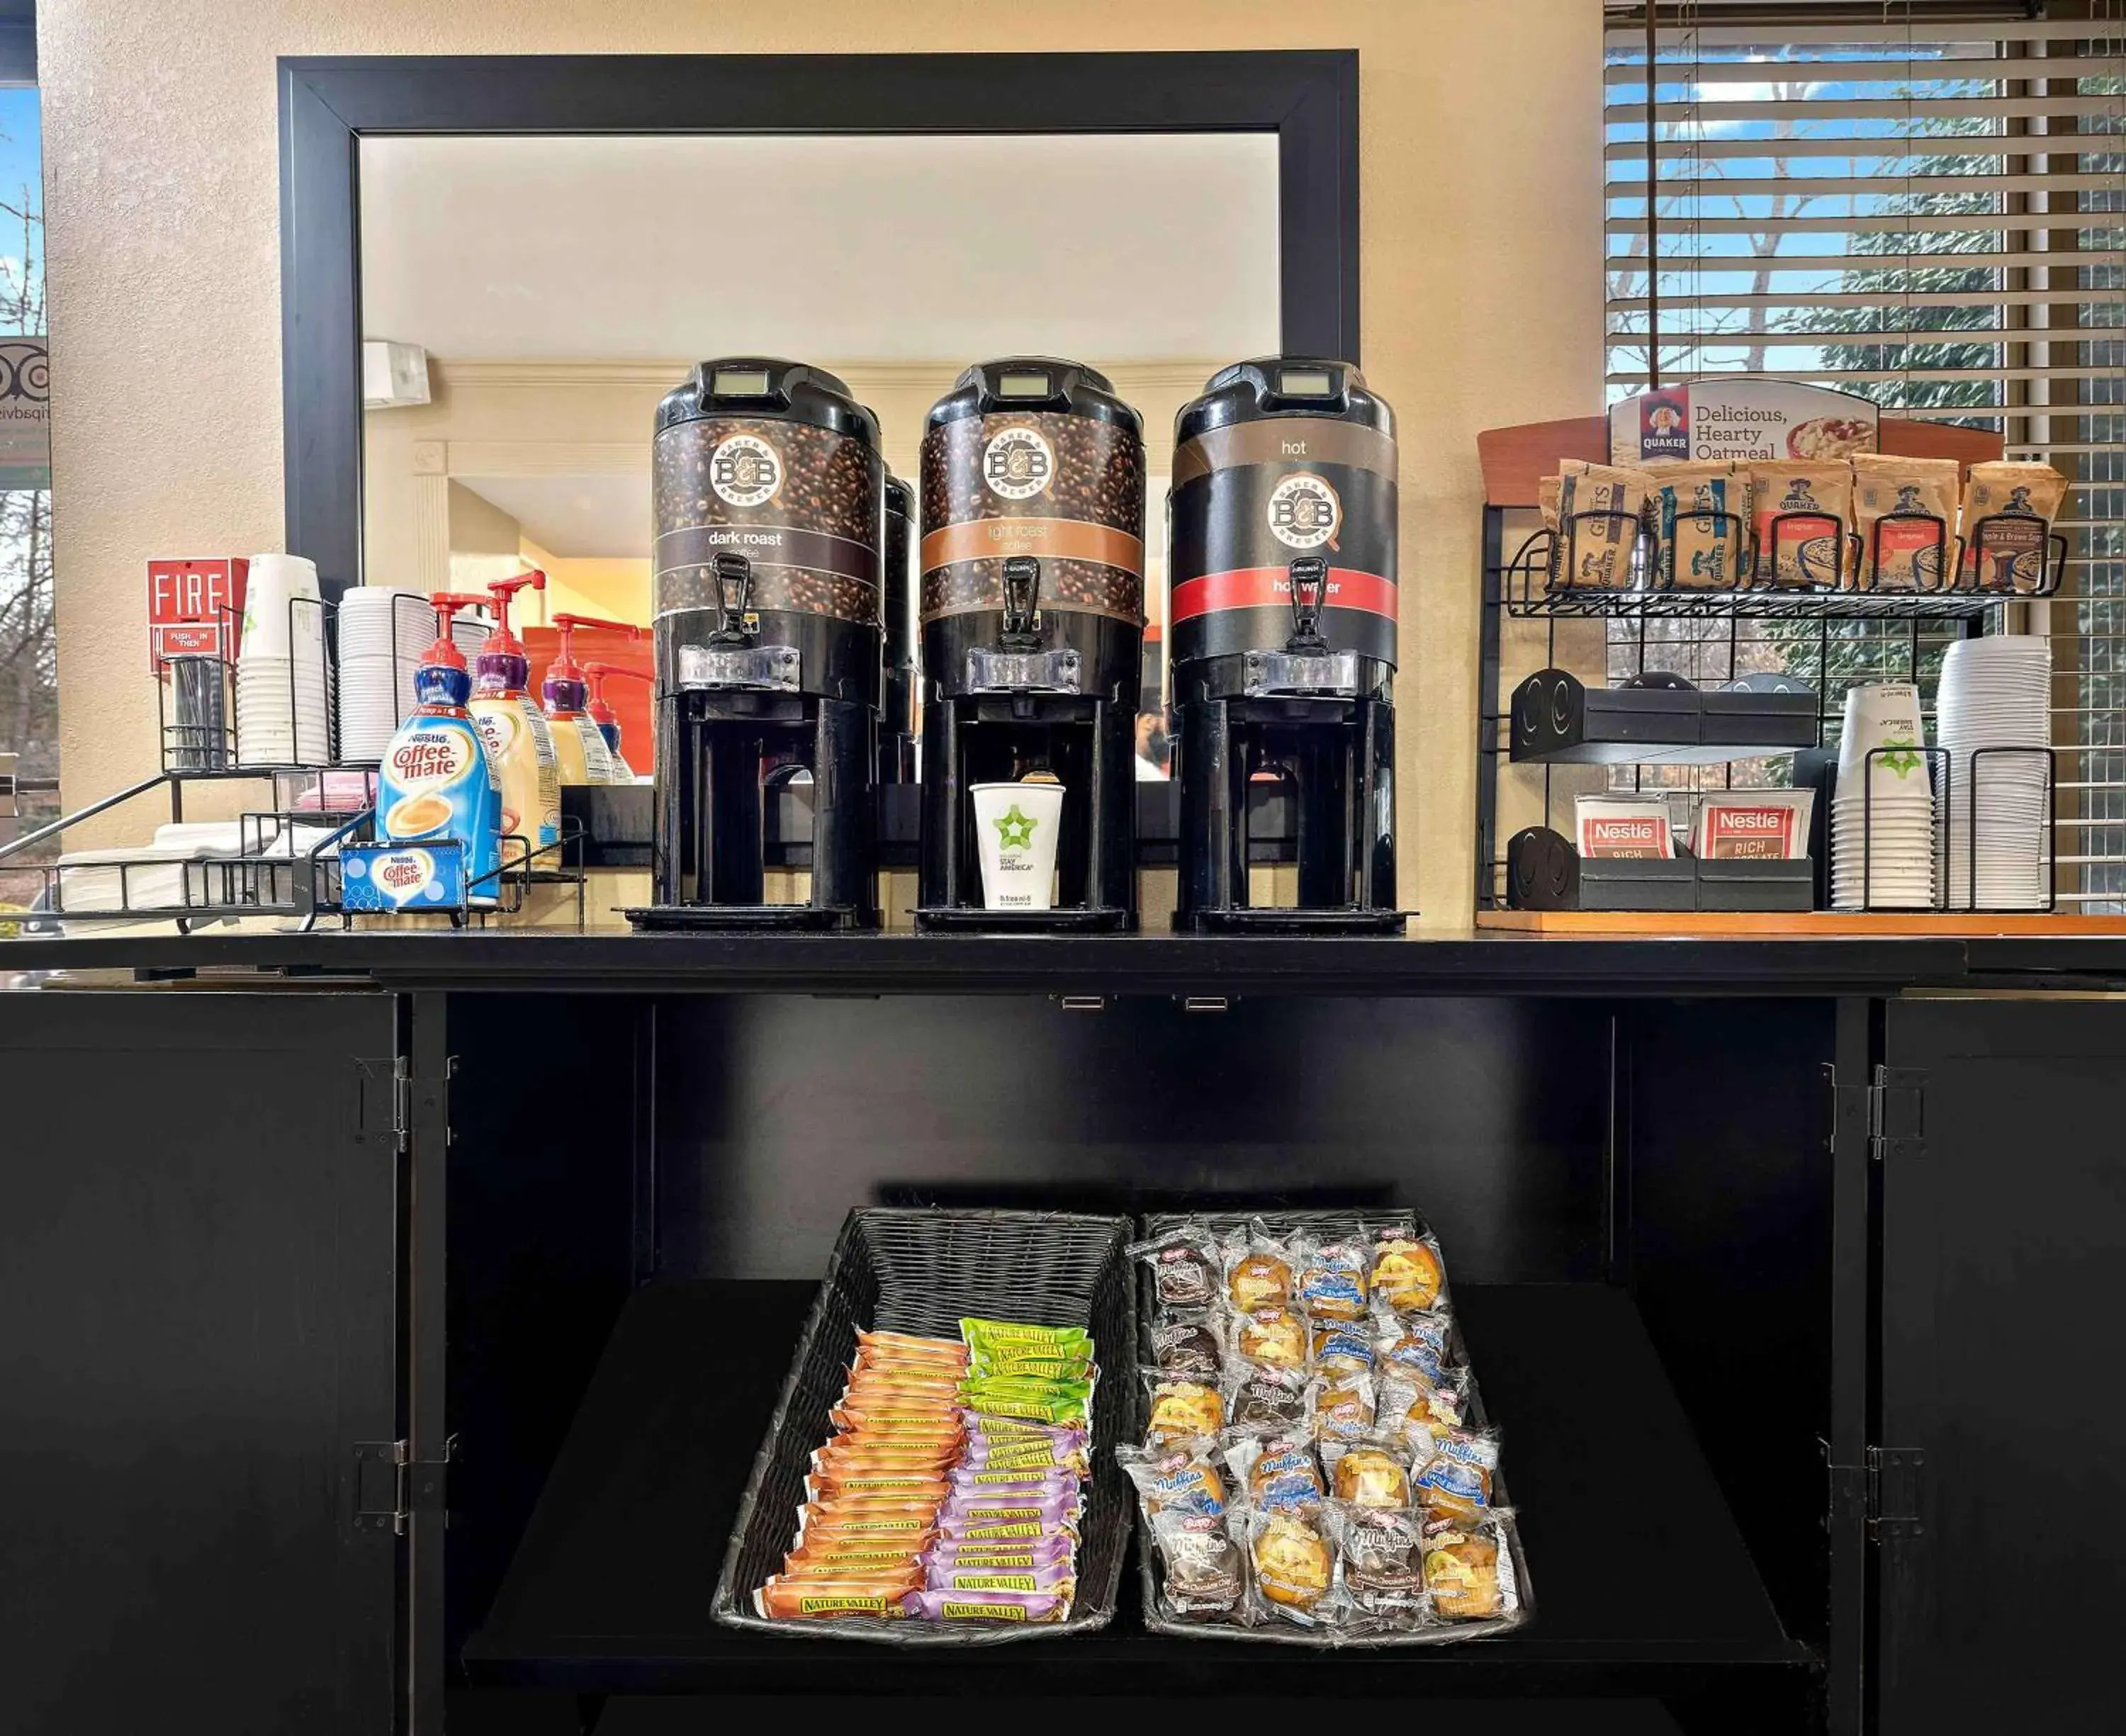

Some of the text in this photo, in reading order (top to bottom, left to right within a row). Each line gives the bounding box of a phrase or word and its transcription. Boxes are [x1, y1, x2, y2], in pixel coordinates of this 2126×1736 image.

[1696, 405, 1787, 424] Delicious,
[1643, 438, 1687, 449] QUAKER
[1696, 426, 1762, 445] Hearty
[1282, 440, 1306, 454] hot
[1696, 443, 1775, 461] Oatmeal
[715, 456, 776, 487] B&B
[987, 449, 1048, 478] B&B
[1273, 497, 1333, 529] B&B
[1780, 502, 1820, 511] QUAKER
[709, 532, 782, 546] dark roast
[1714, 543, 1725, 581] QUAKER
[154, 574, 223, 616] FIRE
[408, 733, 448, 743] Nestlé
[403, 759, 457, 779] mate
[1735, 840, 1765, 855] RICH
[393, 873, 422, 889] mate
[1436, 1438, 1483, 1464] Muffins
[1262, 1454, 1310, 1472] Muffins
[1156, 1470, 1203, 1490] Muffins
[1429, 1472, 1482, 1497] Wild Blueberry
[1363, 1529, 1413, 1550] Muffins
[957, 1577, 1030, 1590] NATURE VALLEY
[804, 1599, 883, 1611] NATURE VALLEY
[946, 1603, 1023, 1618] NATURE VALLEY
